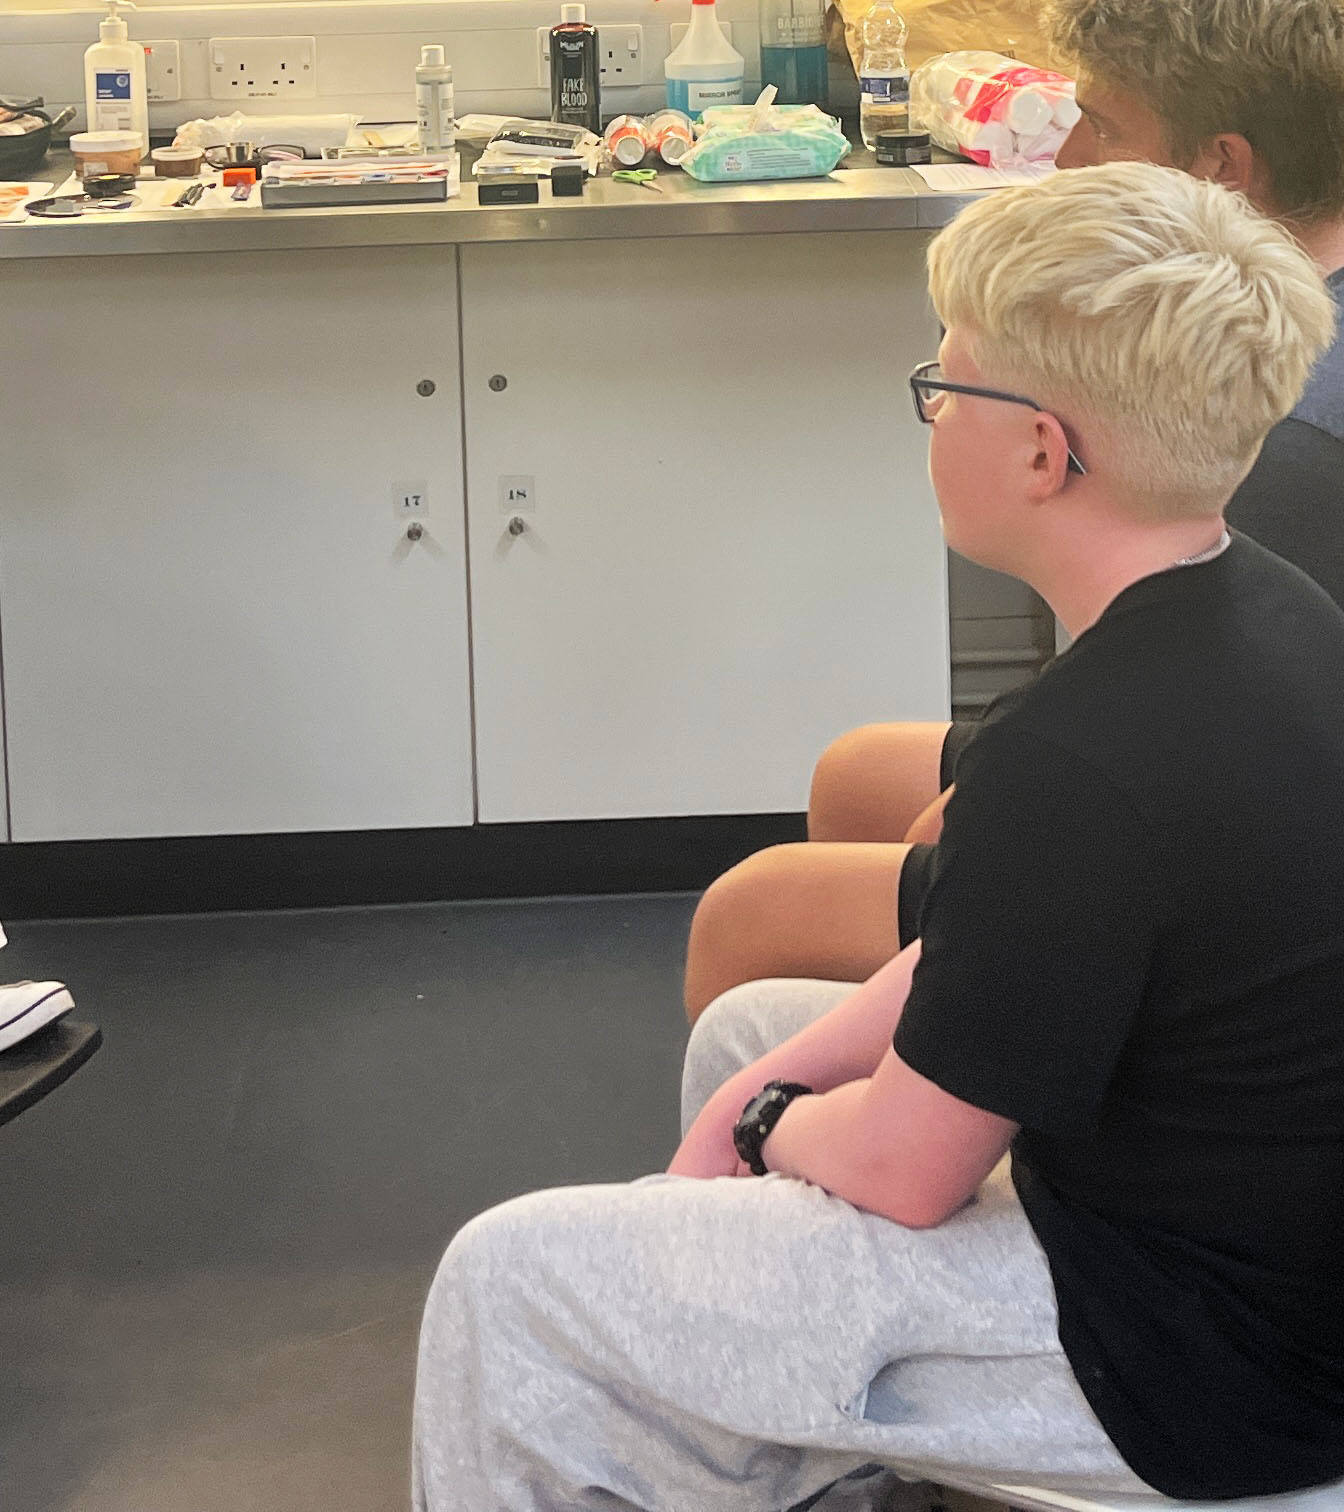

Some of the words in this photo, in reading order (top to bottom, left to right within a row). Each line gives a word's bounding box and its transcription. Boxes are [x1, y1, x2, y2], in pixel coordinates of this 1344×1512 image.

[562, 78, 584, 92] FAKE
[561, 92, 588, 107] BLOOD
[404, 495, 421, 508] 17
